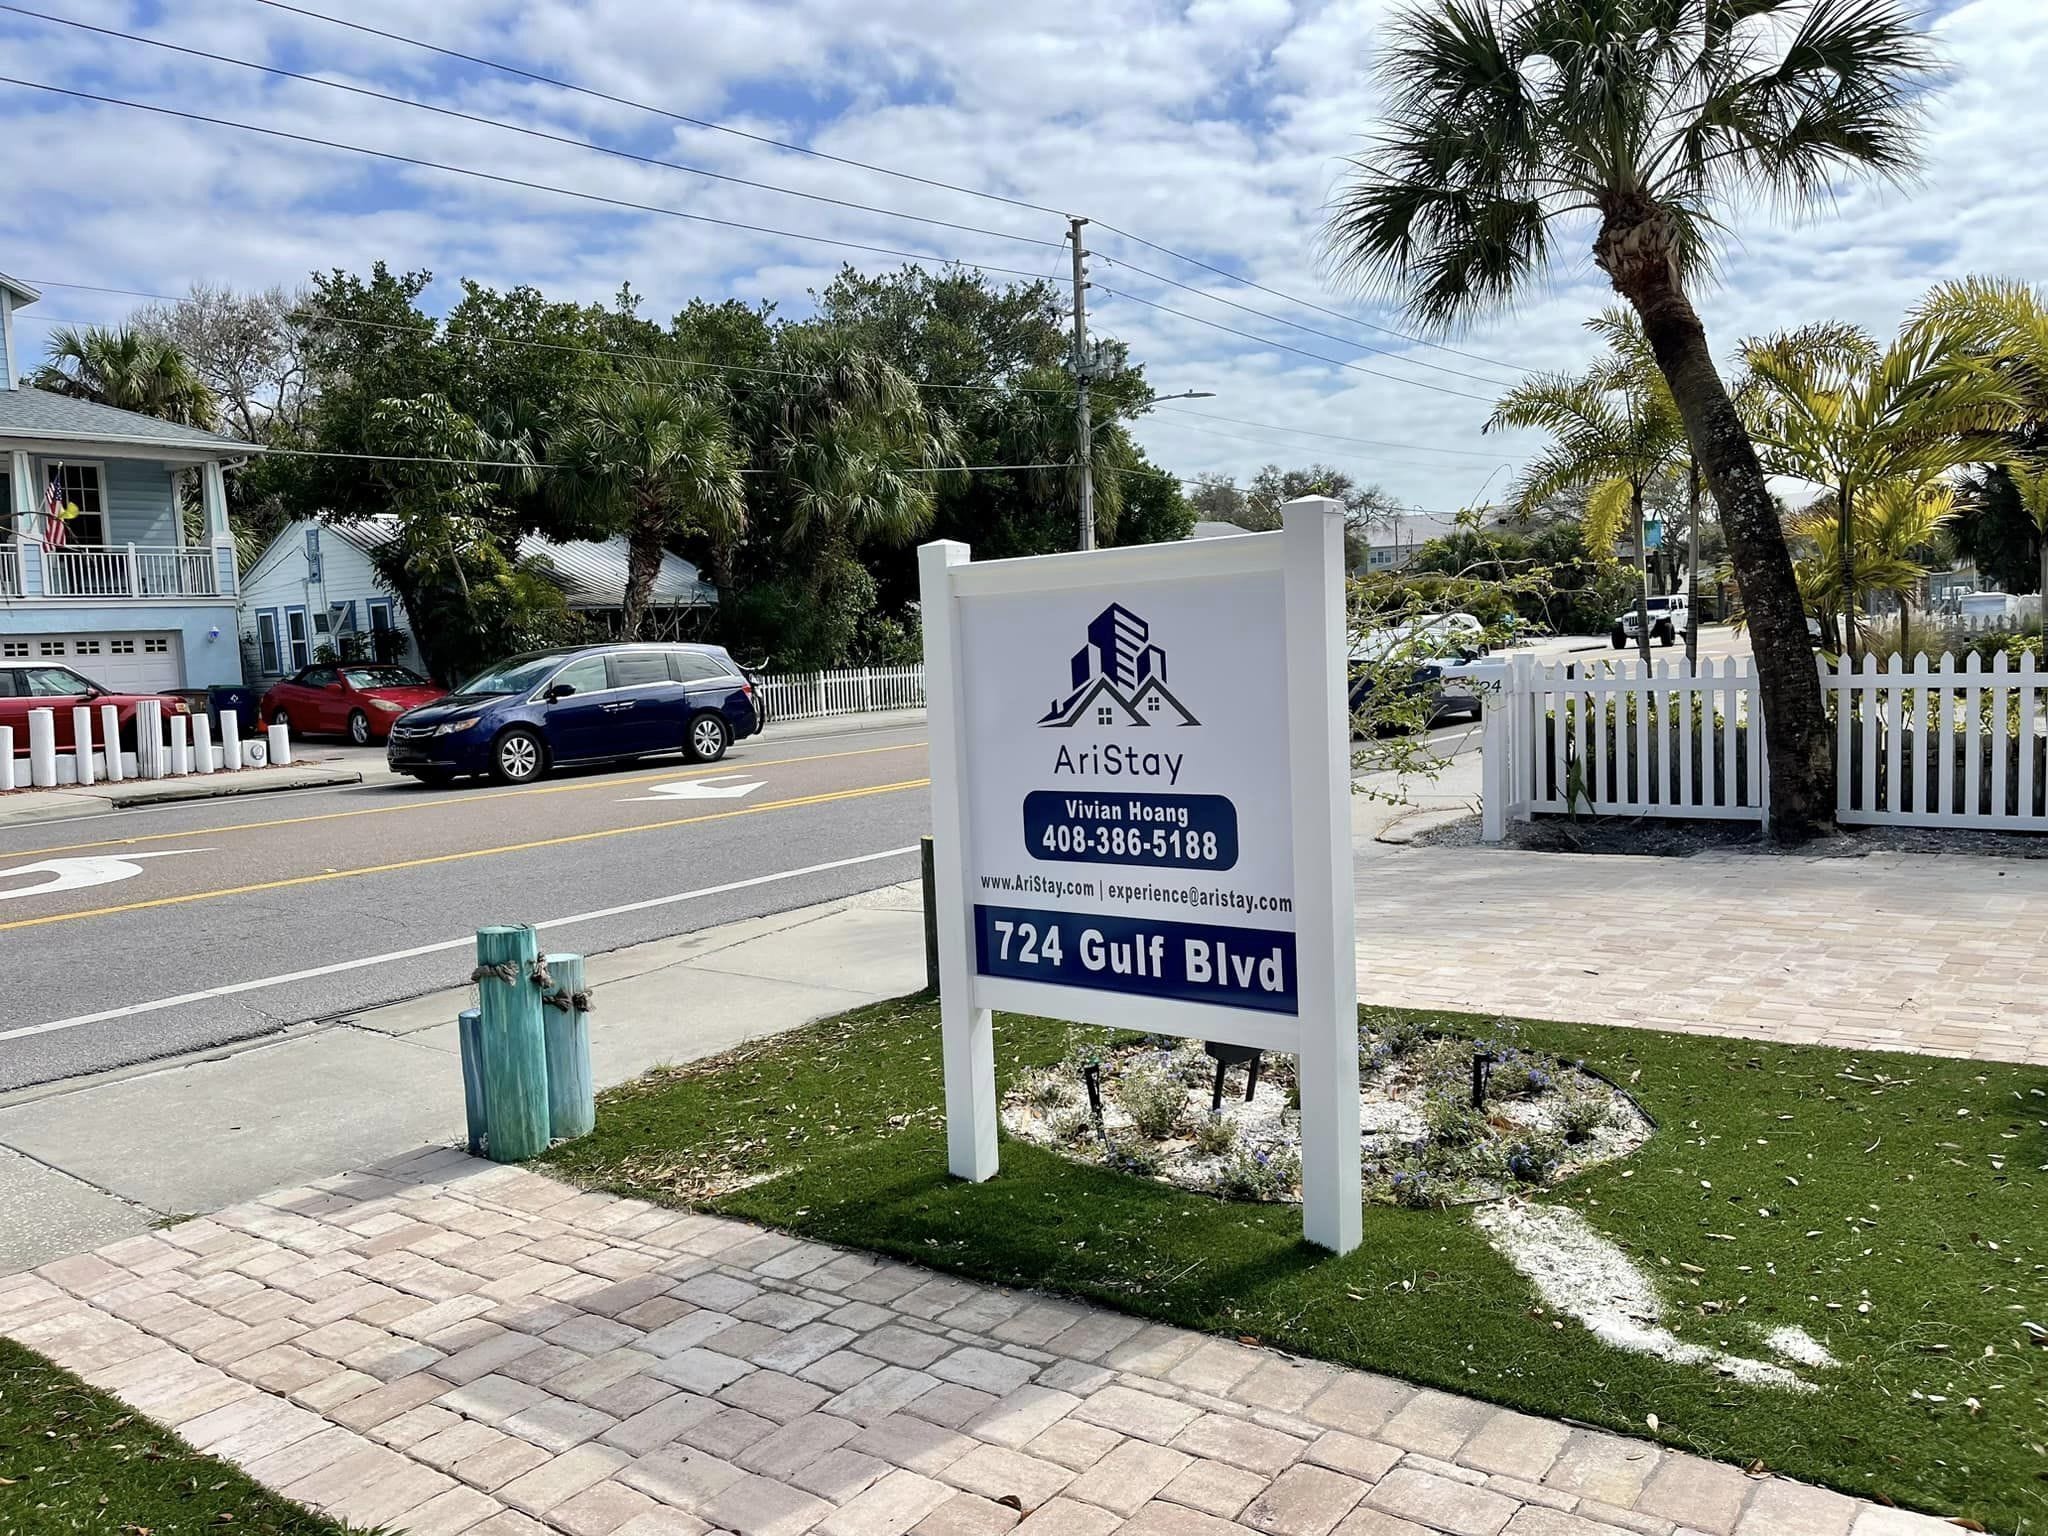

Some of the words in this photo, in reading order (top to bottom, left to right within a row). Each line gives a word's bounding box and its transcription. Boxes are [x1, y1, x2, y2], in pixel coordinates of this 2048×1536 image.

[1054, 744, 1184, 786] AriStay
[1065, 799, 1122, 821] Vivian
[1129, 801, 1189, 828] Hoang
[1042, 824, 1218, 861] 408-386-5188
[981, 874, 1094, 898] www.AriStay.com
[1108, 884, 1293, 914] experience@aristay.com
[994, 920, 1063, 966] 724
[1079, 929, 1164, 978] Gulf
[1184, 938, 1284, 993] Blvd
